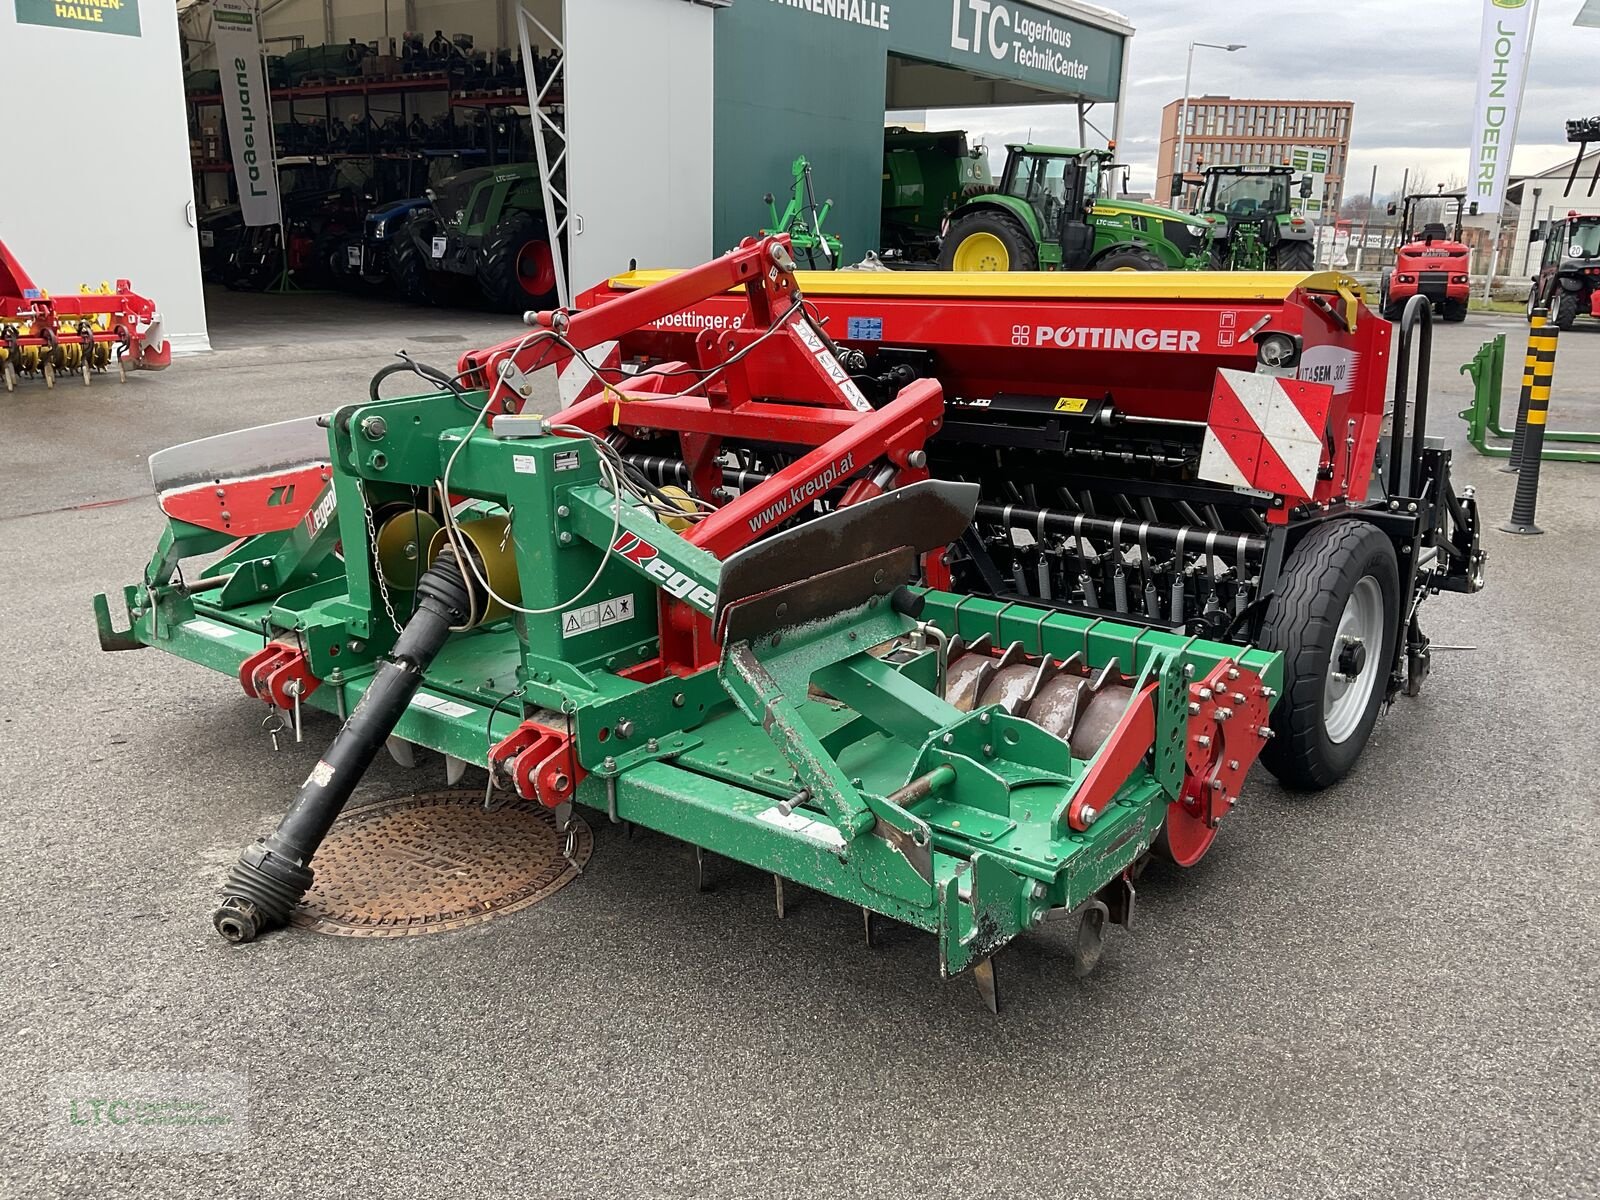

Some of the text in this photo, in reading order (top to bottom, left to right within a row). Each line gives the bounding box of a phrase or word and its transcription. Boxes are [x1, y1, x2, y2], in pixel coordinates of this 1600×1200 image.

[55, 4, 104, 22] HALLE
[951, 0, 1011, 60] LTC
[1014, 11, 1072, 48] Lagerhaus
[1012, 41, 1089, 80] TechnikCenter
[1477, 20, 1516, 197] JOHN DEERE
[1096, 218, 1107, 226] LTC
[1571, 246, 1581, 256] 20
[647, 310, 746, 329] .poettinger.a
[1333, 364, 1346, 381] 300
[748, 451, 855, 533] www.kreupl.at
[611, 529, 717, 614] Rege
